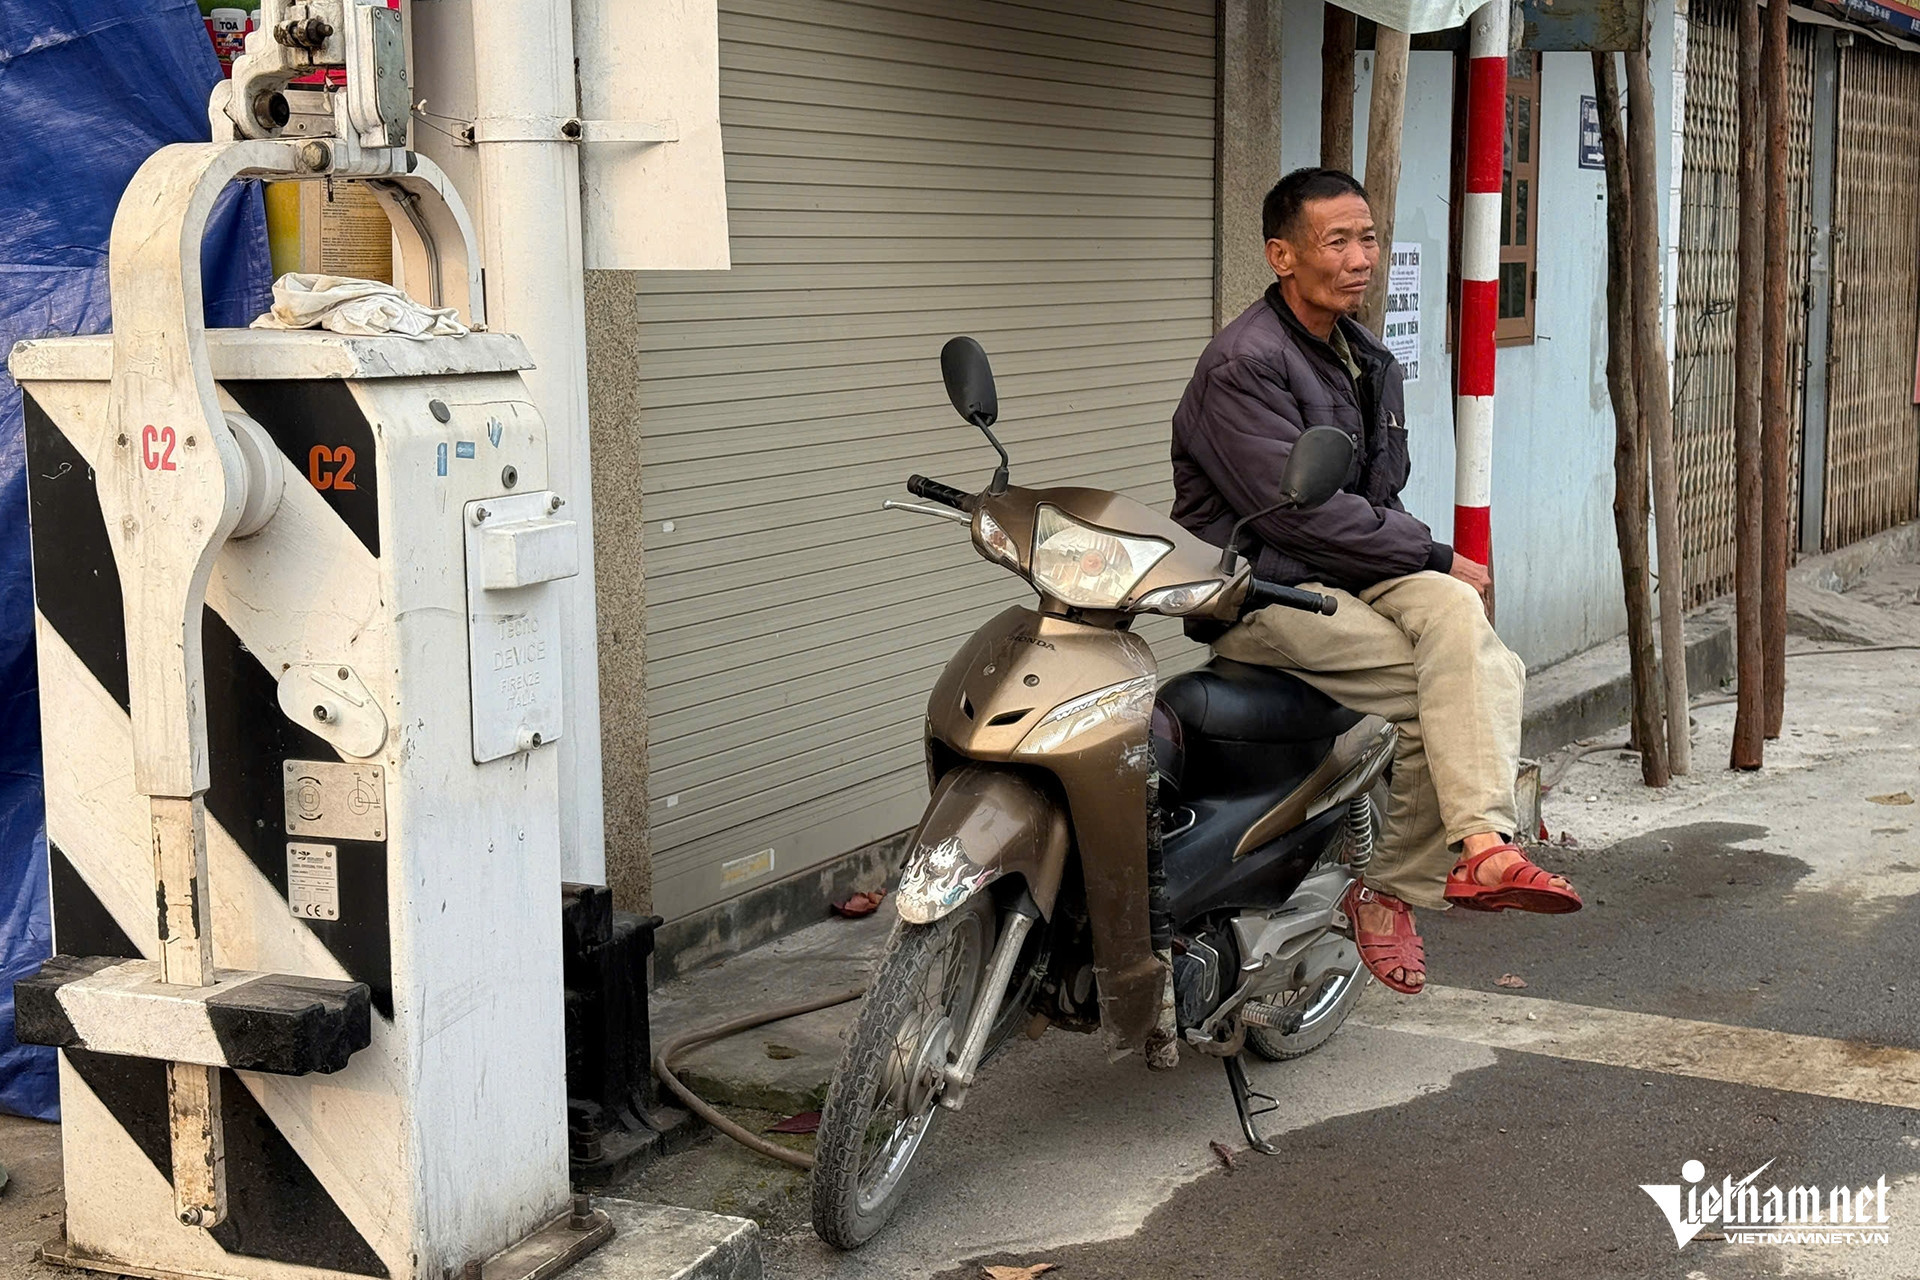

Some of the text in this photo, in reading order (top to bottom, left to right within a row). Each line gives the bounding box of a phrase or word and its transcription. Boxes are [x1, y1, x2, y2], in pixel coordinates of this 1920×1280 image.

[219, 21, 239, 31] TOA
[1386, 323, 1396, 338] CHO
[141, 424, 177, 472] C2
[308, 444, 357, 491] C2
[1006, 634, 1056, 652] HONDA
[493, 641, 546, 672] DEVICE
